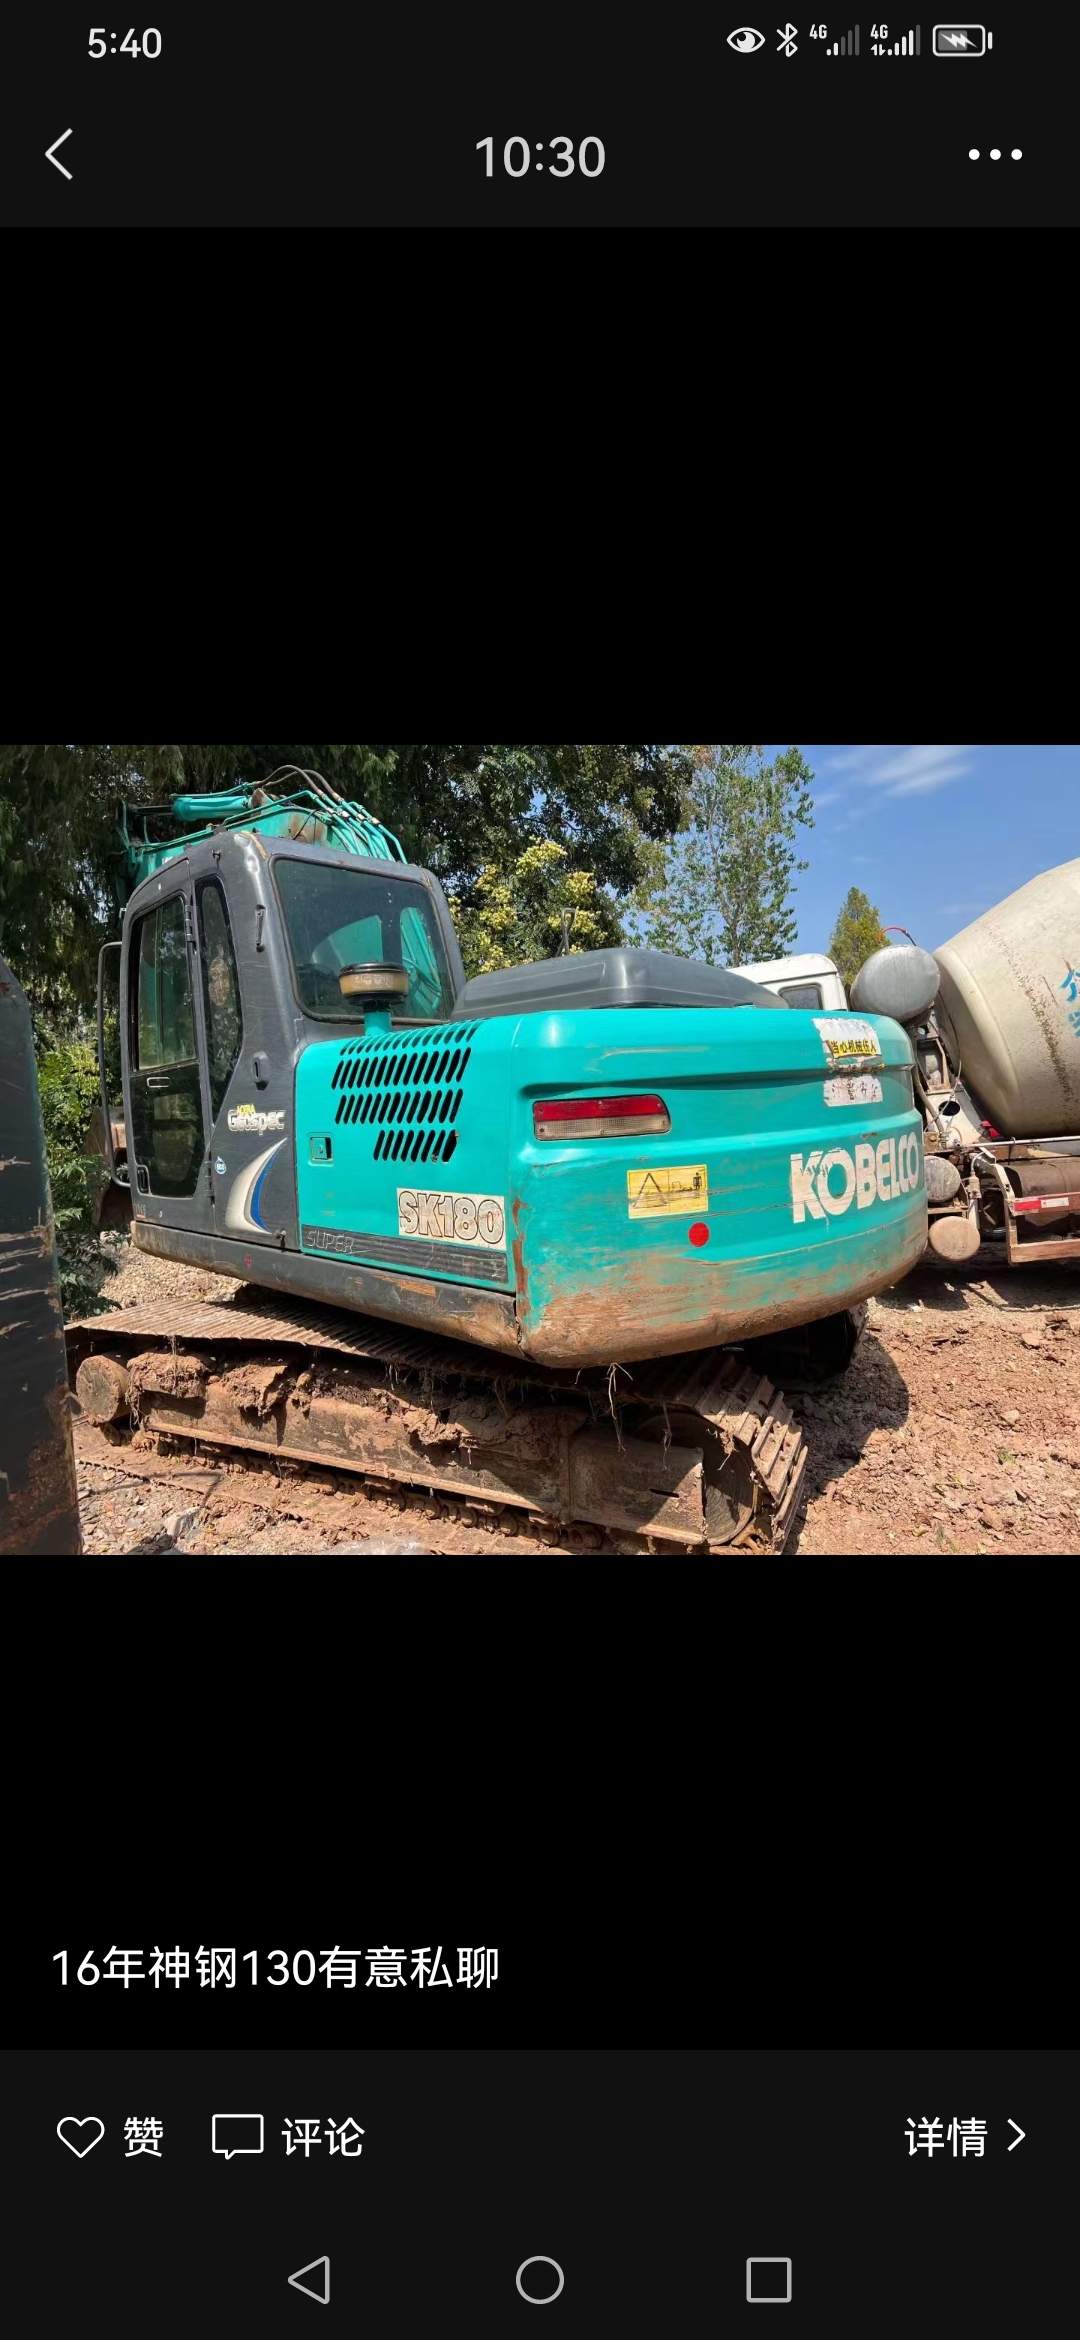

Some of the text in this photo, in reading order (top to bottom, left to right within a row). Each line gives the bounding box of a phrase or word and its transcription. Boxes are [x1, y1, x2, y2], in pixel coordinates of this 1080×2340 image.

[790, 1132, 920, 1224] KOBELCO
[305, 1229, 354, 1254] SUPER
[399, 1190, 504, 1244] SK180
